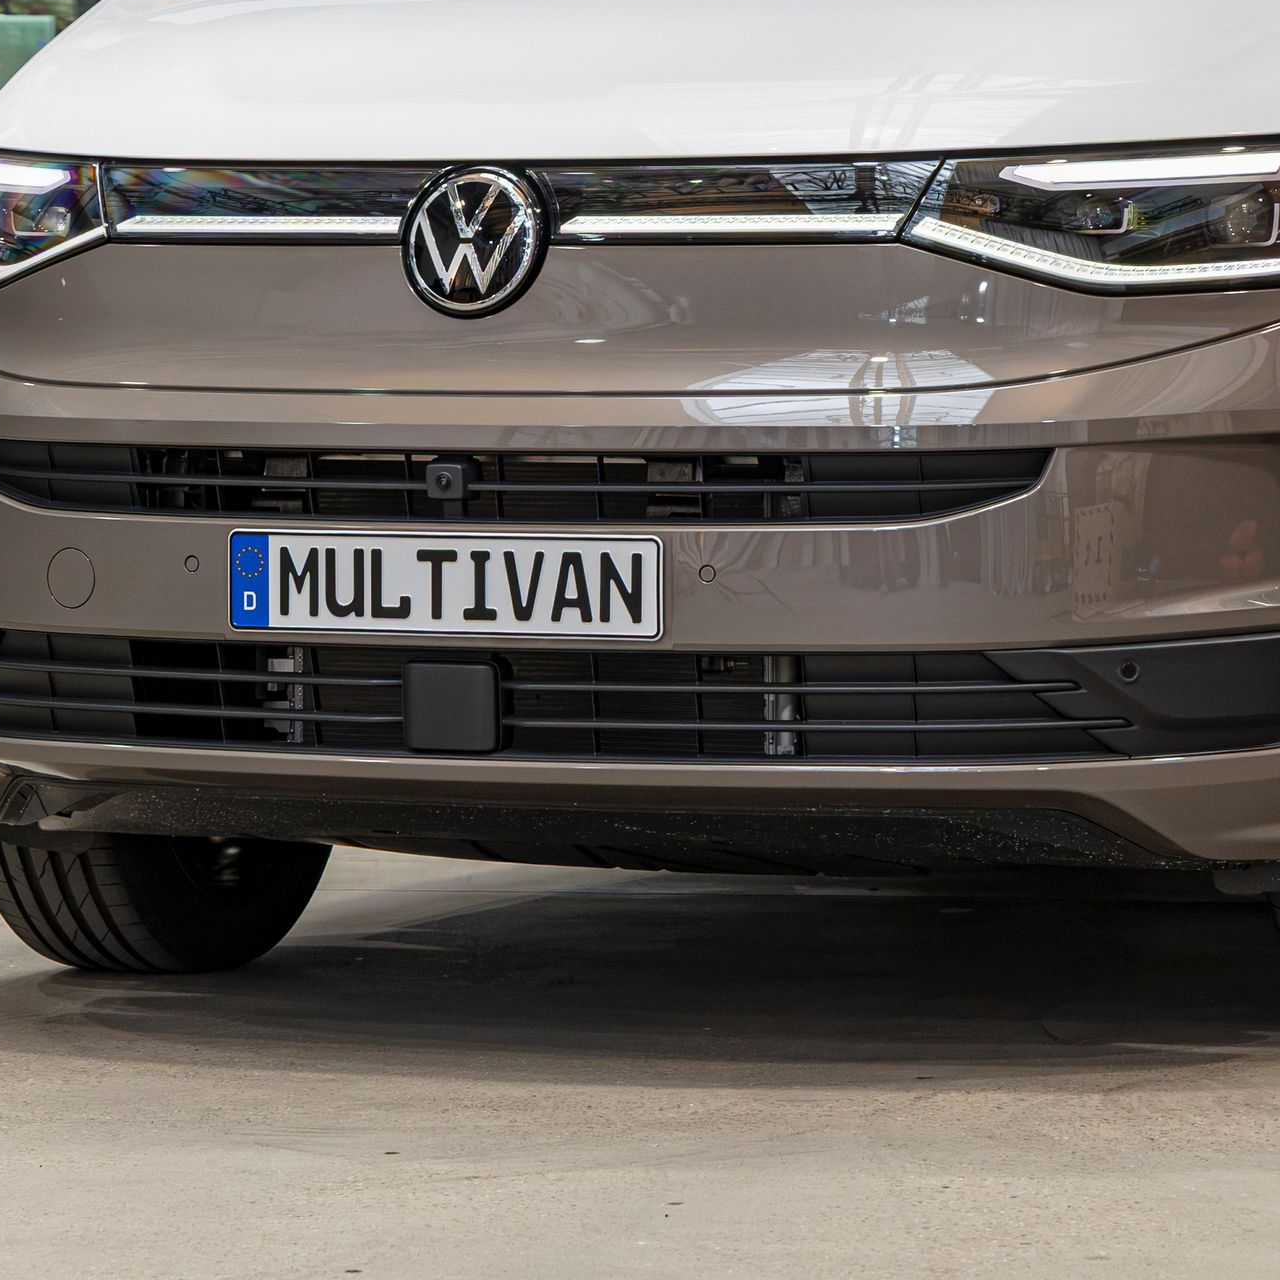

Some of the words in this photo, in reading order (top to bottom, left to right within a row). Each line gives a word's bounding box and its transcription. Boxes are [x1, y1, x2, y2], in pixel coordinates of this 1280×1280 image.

[416, 178, 530, 300] VW
[243, 591, 257, 611] D
[279, 546, 643, 624] MULTIVAN
